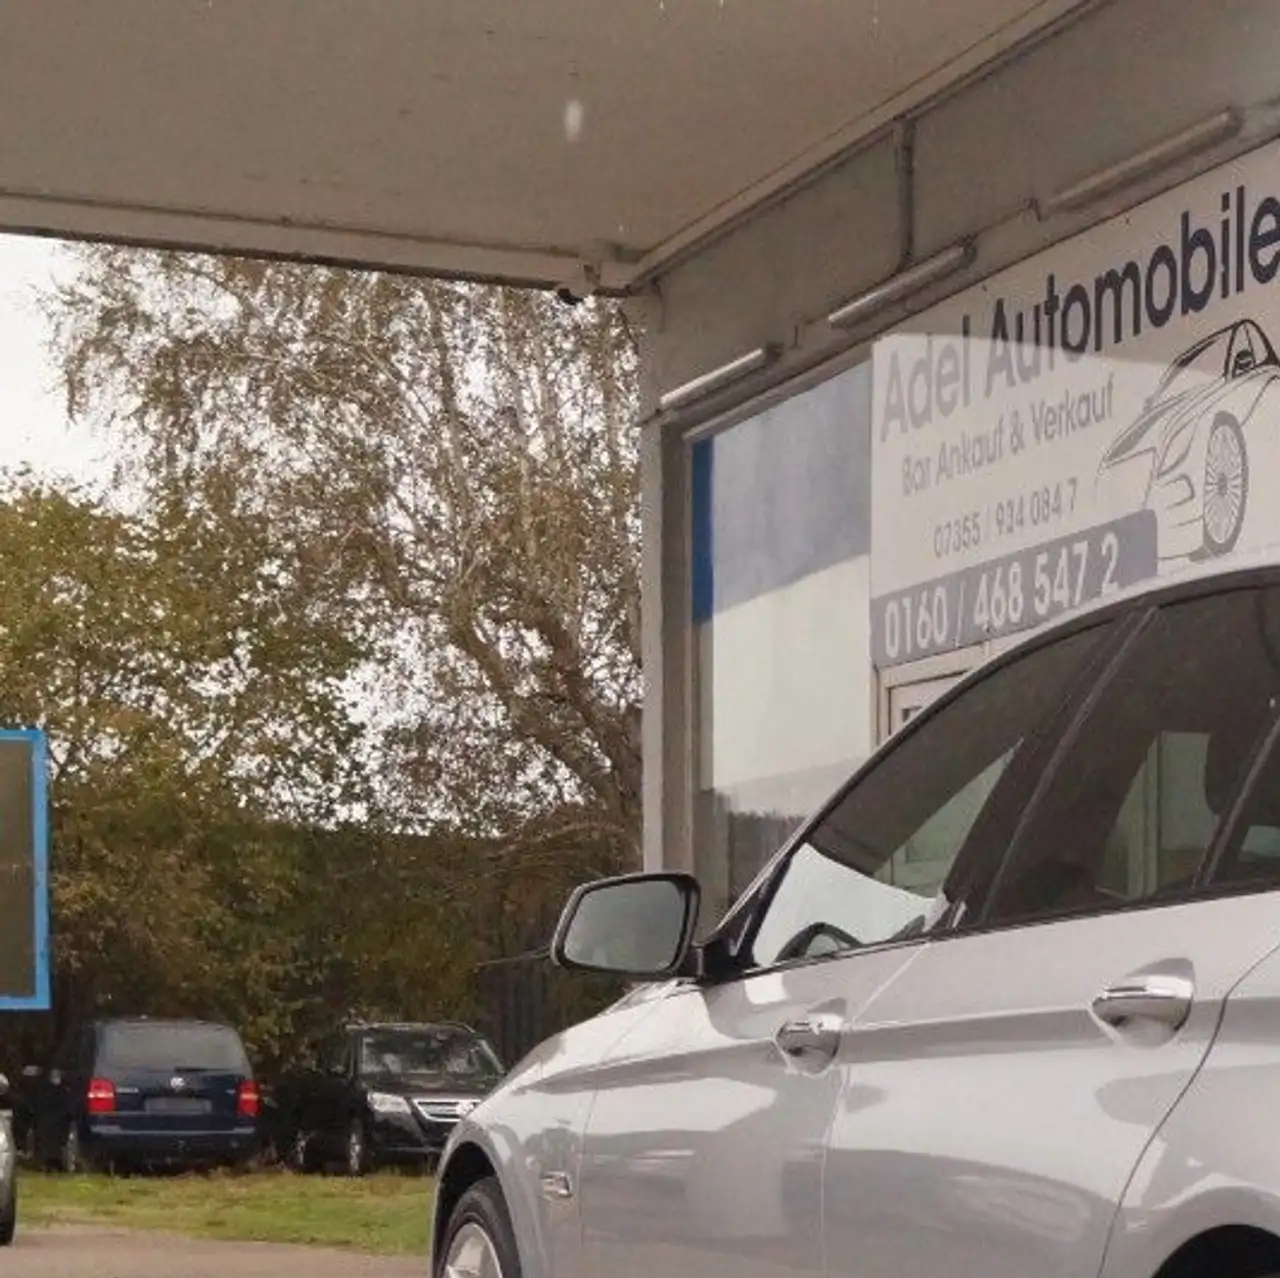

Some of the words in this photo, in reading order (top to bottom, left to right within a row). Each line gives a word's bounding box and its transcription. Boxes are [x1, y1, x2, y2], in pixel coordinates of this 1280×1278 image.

[880, 314, 971, 442] Adel
[902, 453, 931, 497] Bar
[934, 412, 1004, 486] Ankauf
[1010, 409, 1025, 456] &
[1029, 371, 1115, 446] Verkauf
[884, 585, 949, 659] 0160
[953, 580, 966, 648] /
[973, 560, 1023, 630] 468
[1034, 540, 1089, 616] 547
[1101, 531, 1120, 598] 2
